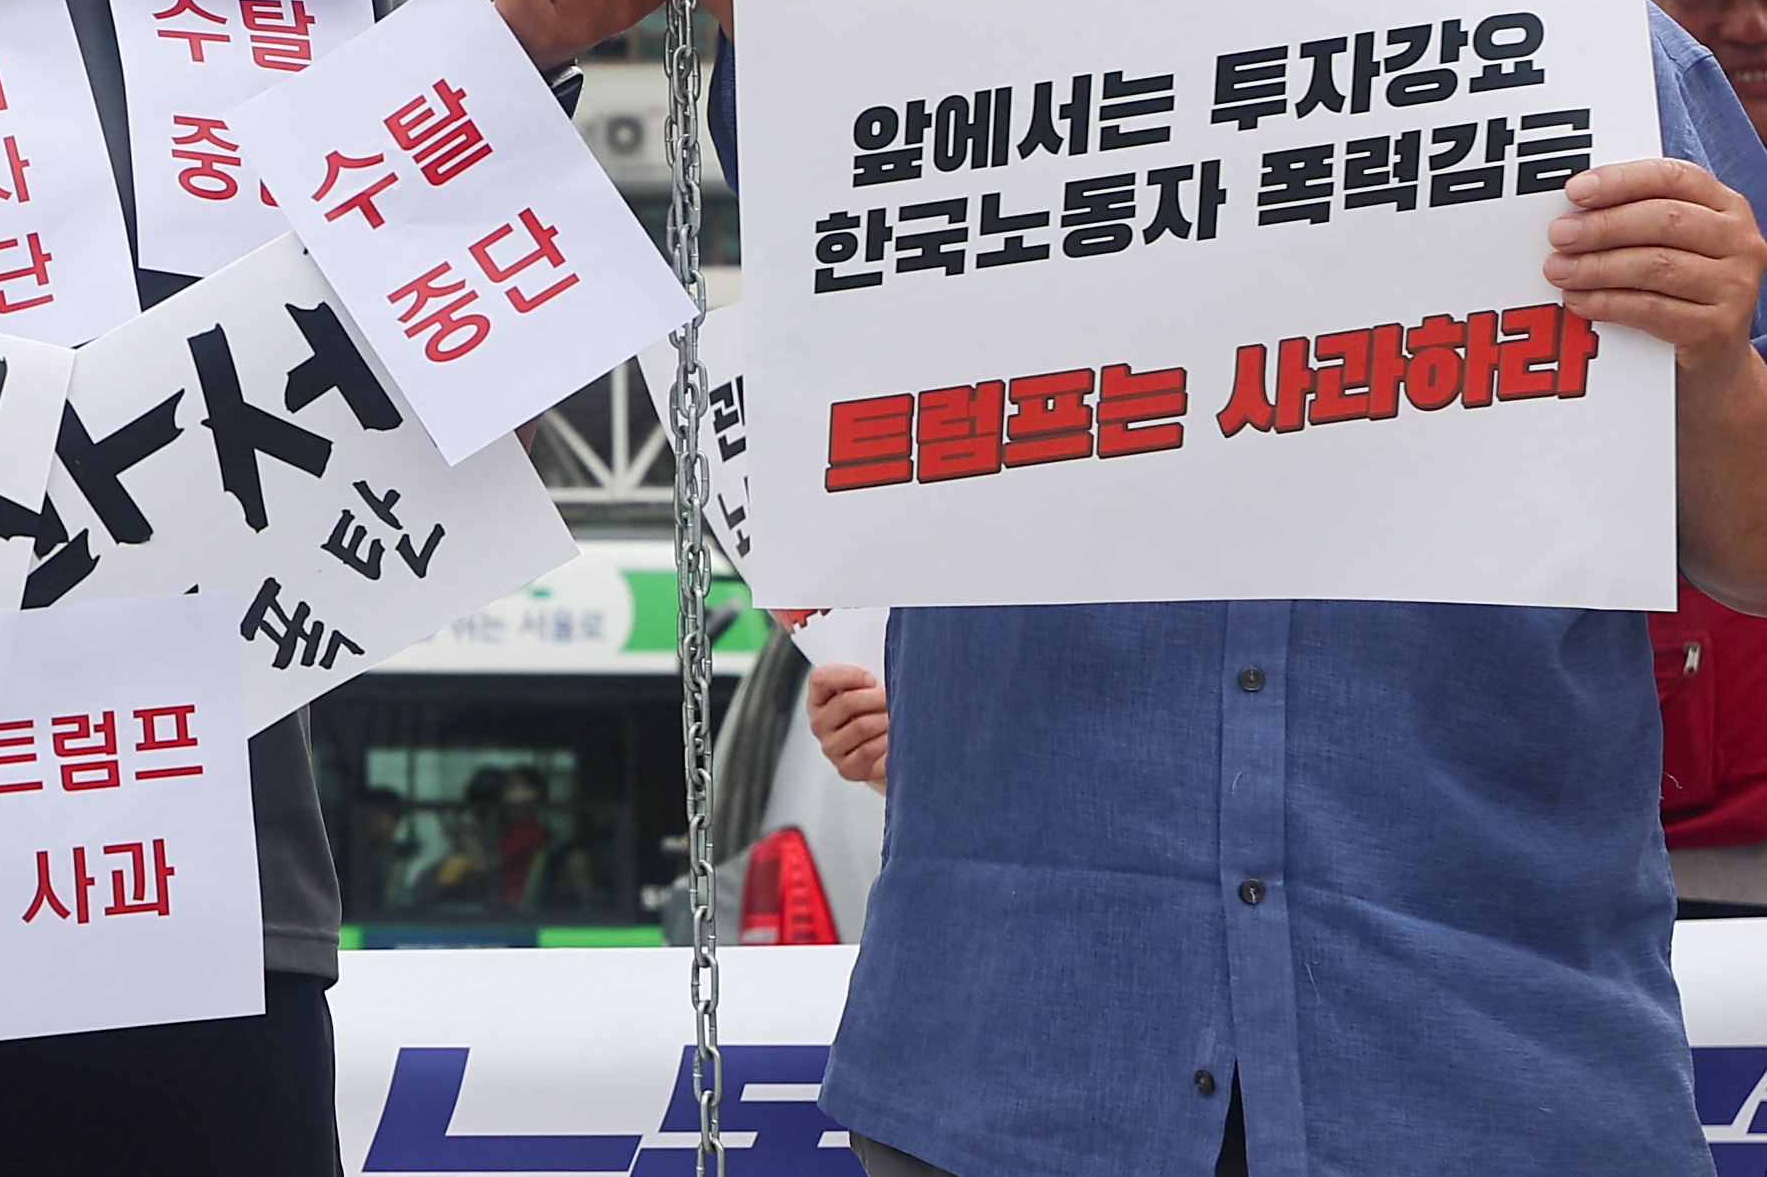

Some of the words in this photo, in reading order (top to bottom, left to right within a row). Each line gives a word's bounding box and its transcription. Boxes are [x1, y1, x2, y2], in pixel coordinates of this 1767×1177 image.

[170, 115, 280, 208] 중
[311, 78, 494, 230] 수탈
[851, 69, 1176, 188] 앞에서는
[1210, 11, 1547, 131] 투자강요
[812, 159, 1228, 294] 한국노동자
[1256, 108, 1594, 226] 폭력감금
[386, 207, 581, 363] 중단
[824, 363, 1187, 493] 트럼프는
[1216, 302, 1599, 439] 사과하라
[21, 838, 176, 925] 사과
